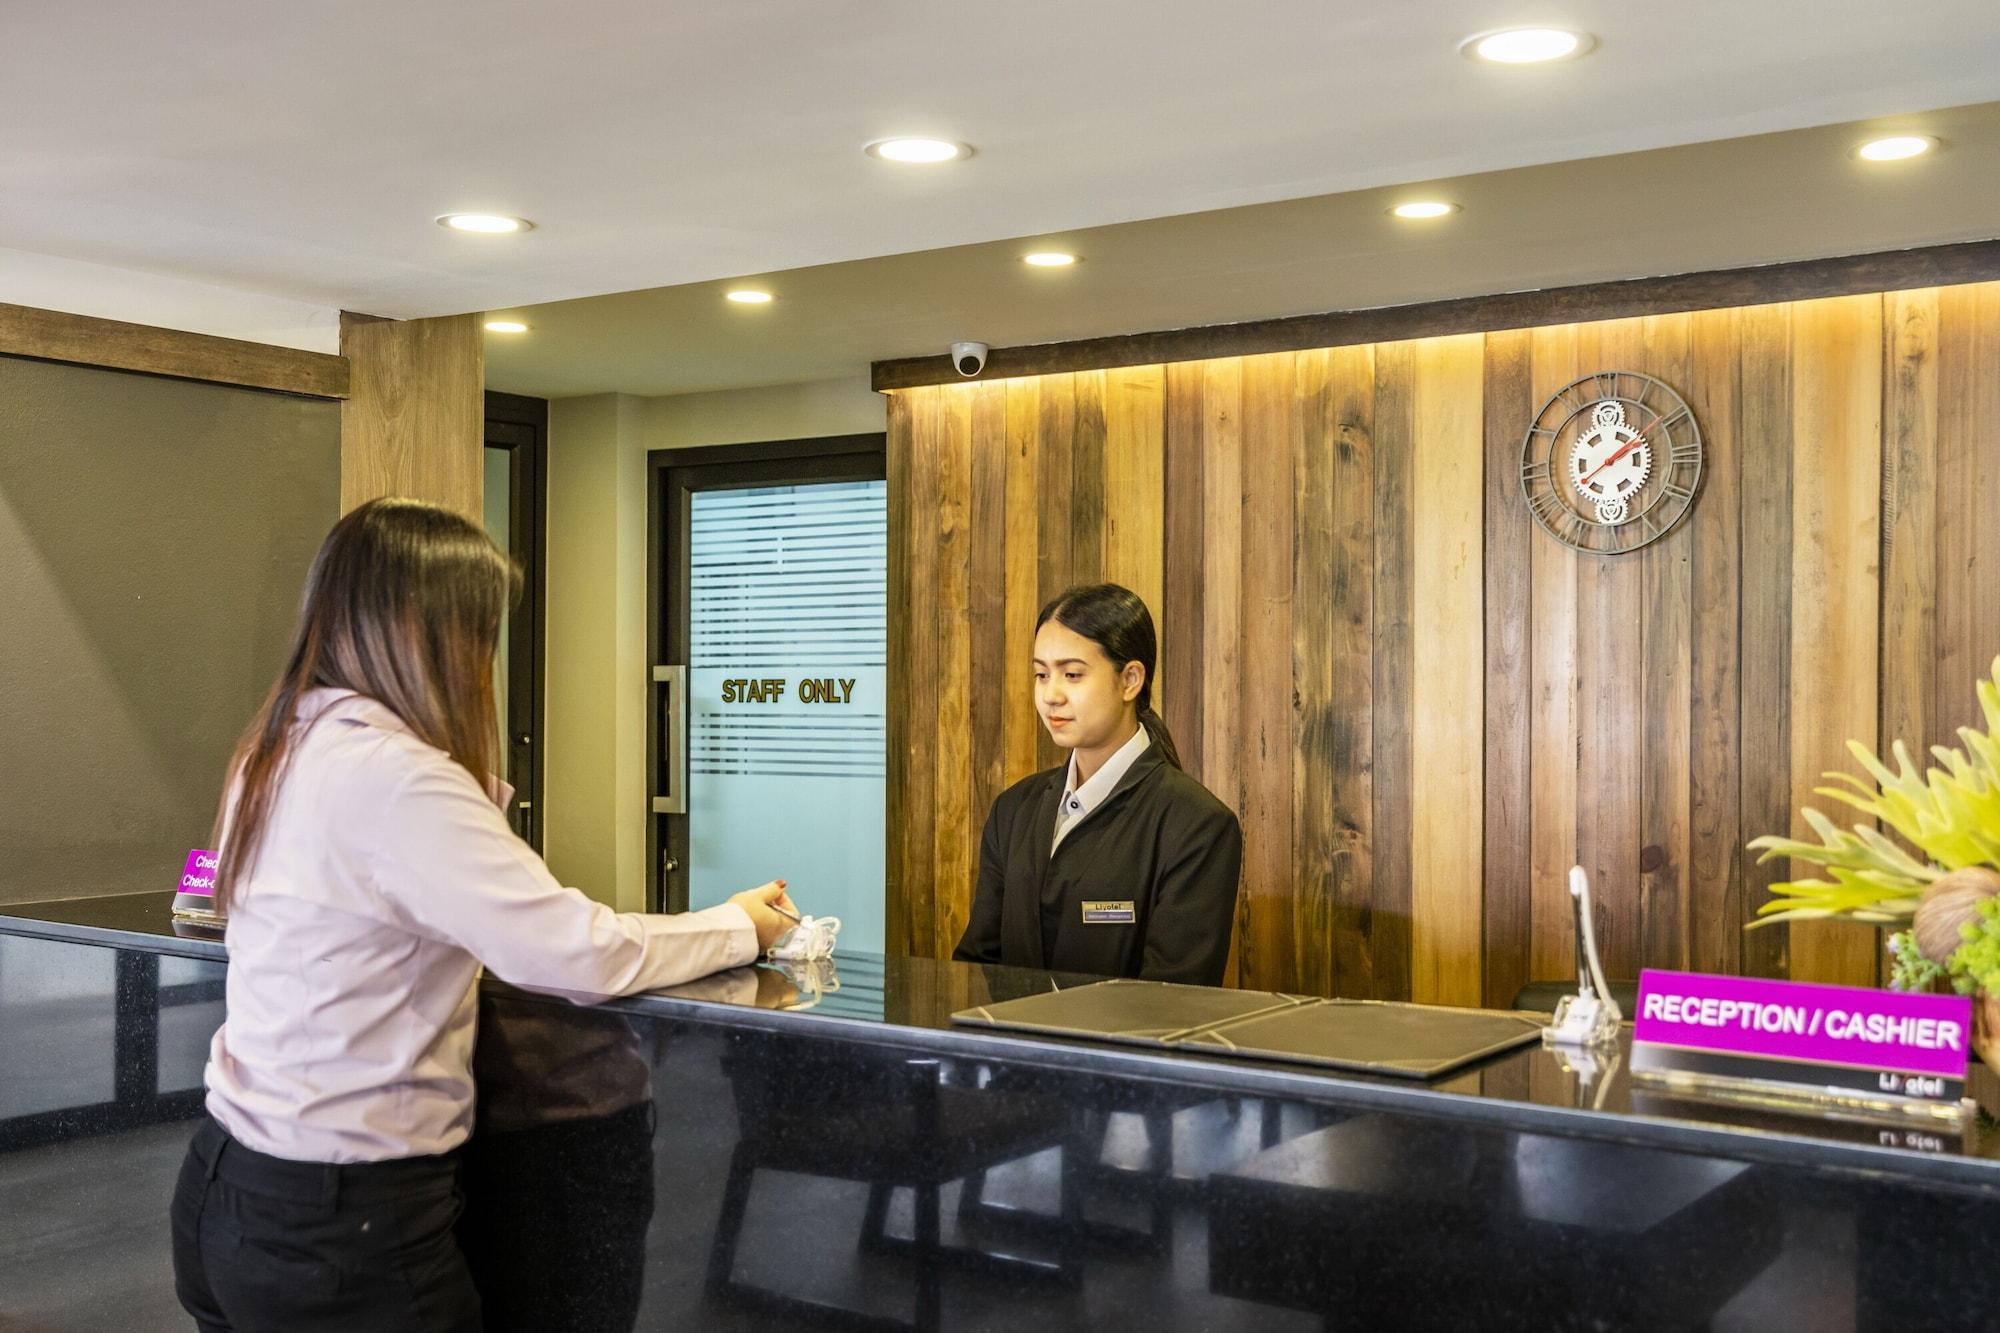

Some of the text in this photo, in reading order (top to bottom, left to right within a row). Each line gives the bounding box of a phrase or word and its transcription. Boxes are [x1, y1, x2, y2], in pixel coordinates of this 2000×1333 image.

[721, 678, 856, 704] STAFF ONLY
[1643, 993, 1806, 1034] RECEPTION
[1824, 1010, 1961, 1051] CASHIER
